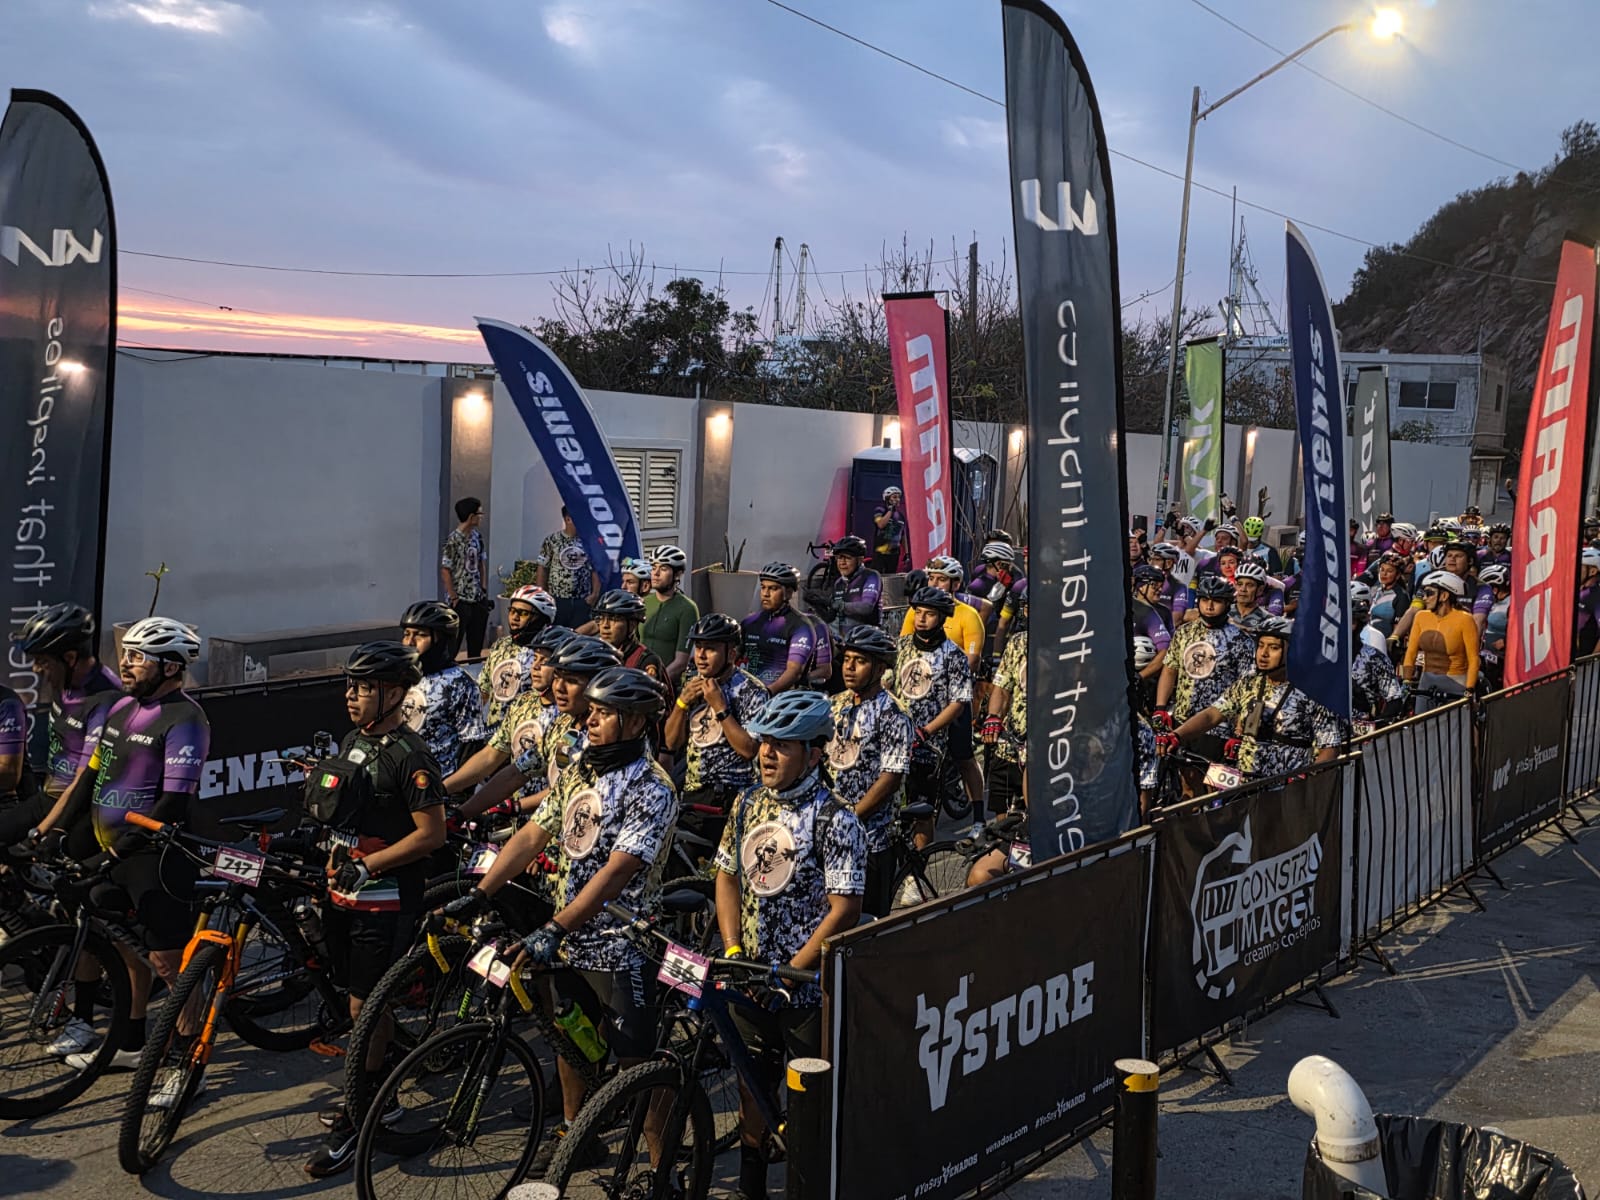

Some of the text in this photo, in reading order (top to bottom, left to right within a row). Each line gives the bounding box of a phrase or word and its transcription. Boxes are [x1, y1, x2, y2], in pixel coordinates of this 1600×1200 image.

[1310, 323, 1342, 664] dportenis
[962, 961, 1095, 1077] STORE
[985, 1125, 1028, 1155] venados.com
